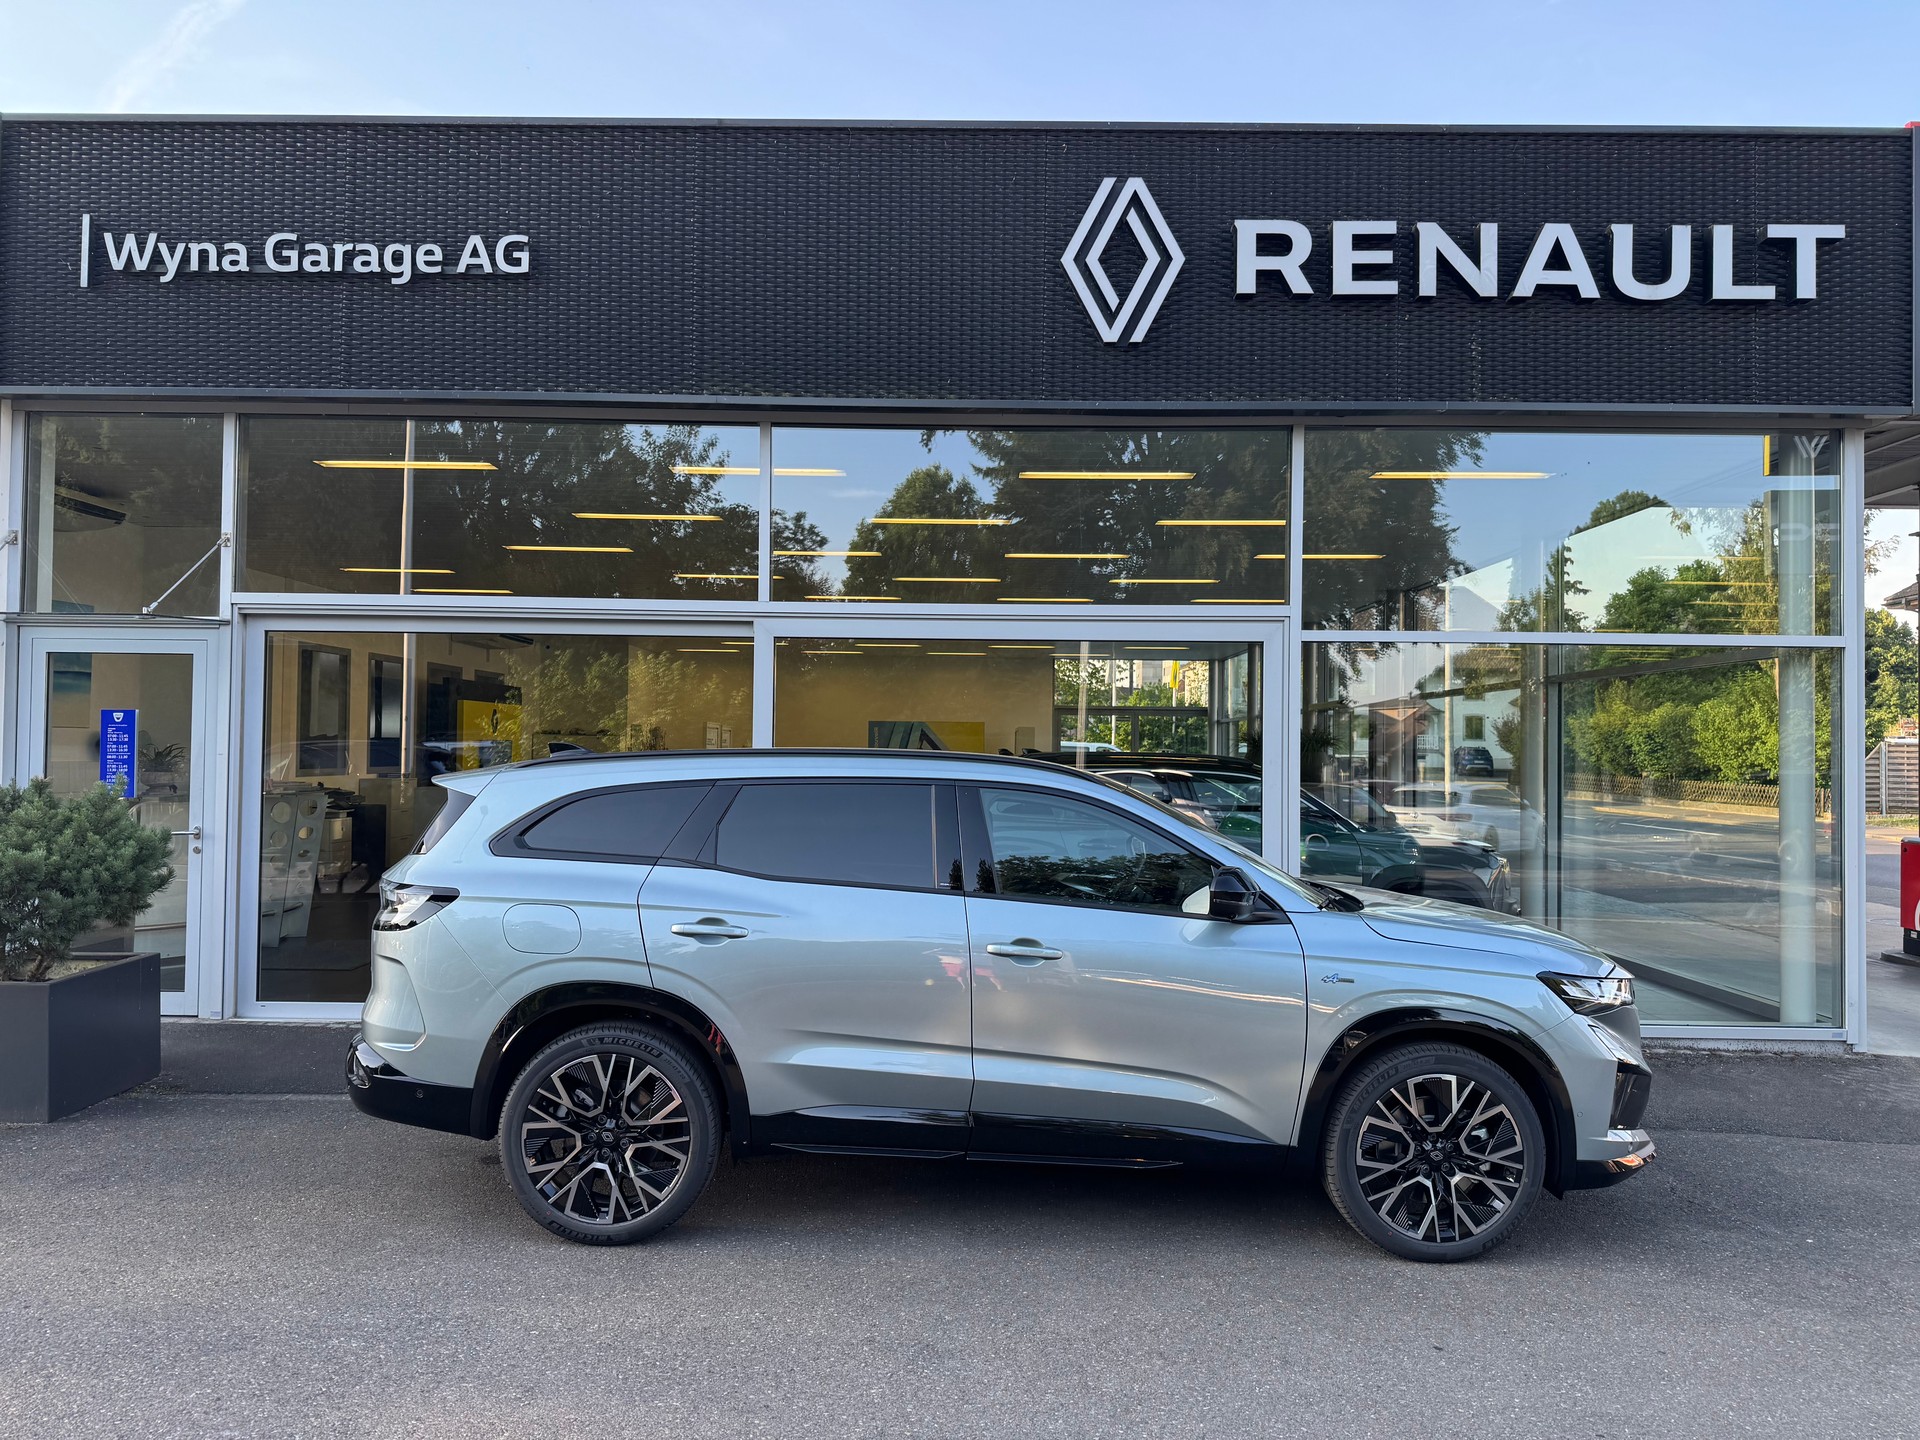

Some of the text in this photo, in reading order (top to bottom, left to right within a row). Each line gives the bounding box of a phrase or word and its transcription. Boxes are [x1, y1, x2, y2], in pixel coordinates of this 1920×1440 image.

[104, 231, 531, 285] Wyna Garage AG
[1234, 219, 1846, 301] RENAULT
[602, 1037, 660, 1057] MICHELIN
[1353, 1066, 1399, 1111] MICHELIN
